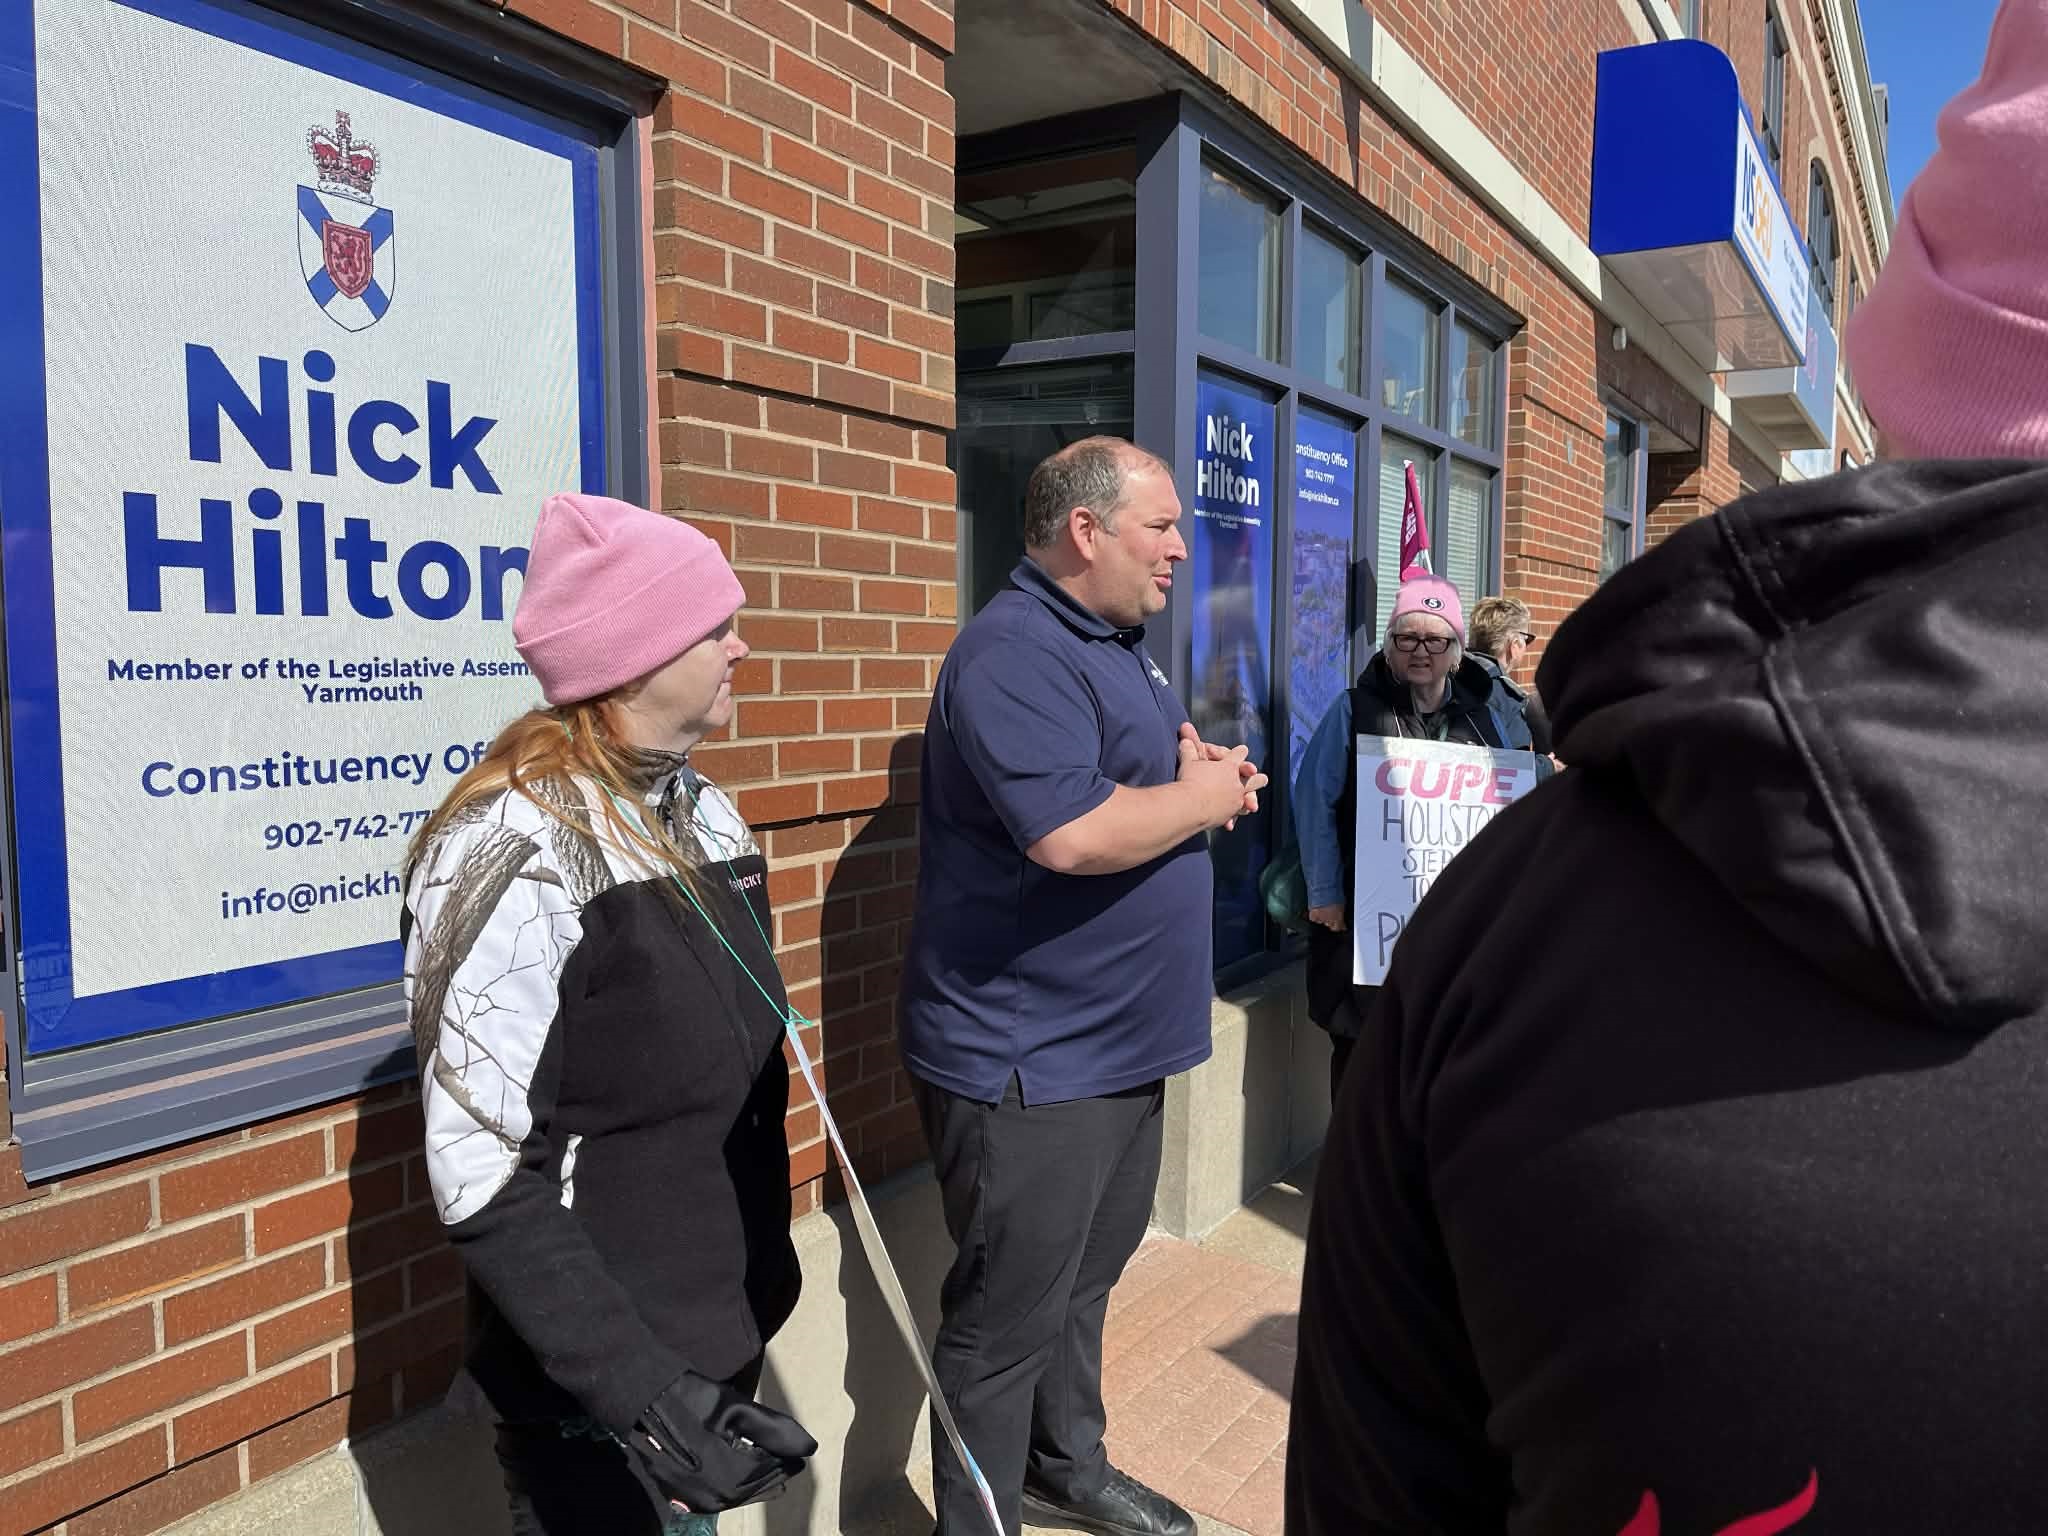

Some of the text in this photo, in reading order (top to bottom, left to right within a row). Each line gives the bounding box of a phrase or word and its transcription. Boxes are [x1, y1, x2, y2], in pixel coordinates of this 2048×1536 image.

[185, 342, 503, 496] Nick
[1206, 414, 1254, 462] Nick
[1295, 443, 1349, 468] onstituency Office
[1197, 458, 1260, 507] Hilton
[123, 487, 531, 622] Hilton
[107, 656, 535, 683] Member of the Legislative Assem
[302, 681, 424, 704] Yarmouth
[141, 741, 496, 798] Constituency Of
[1375, 758, 1518, 804] CUPE
[264, 810, 437, 850] 902-742-77
